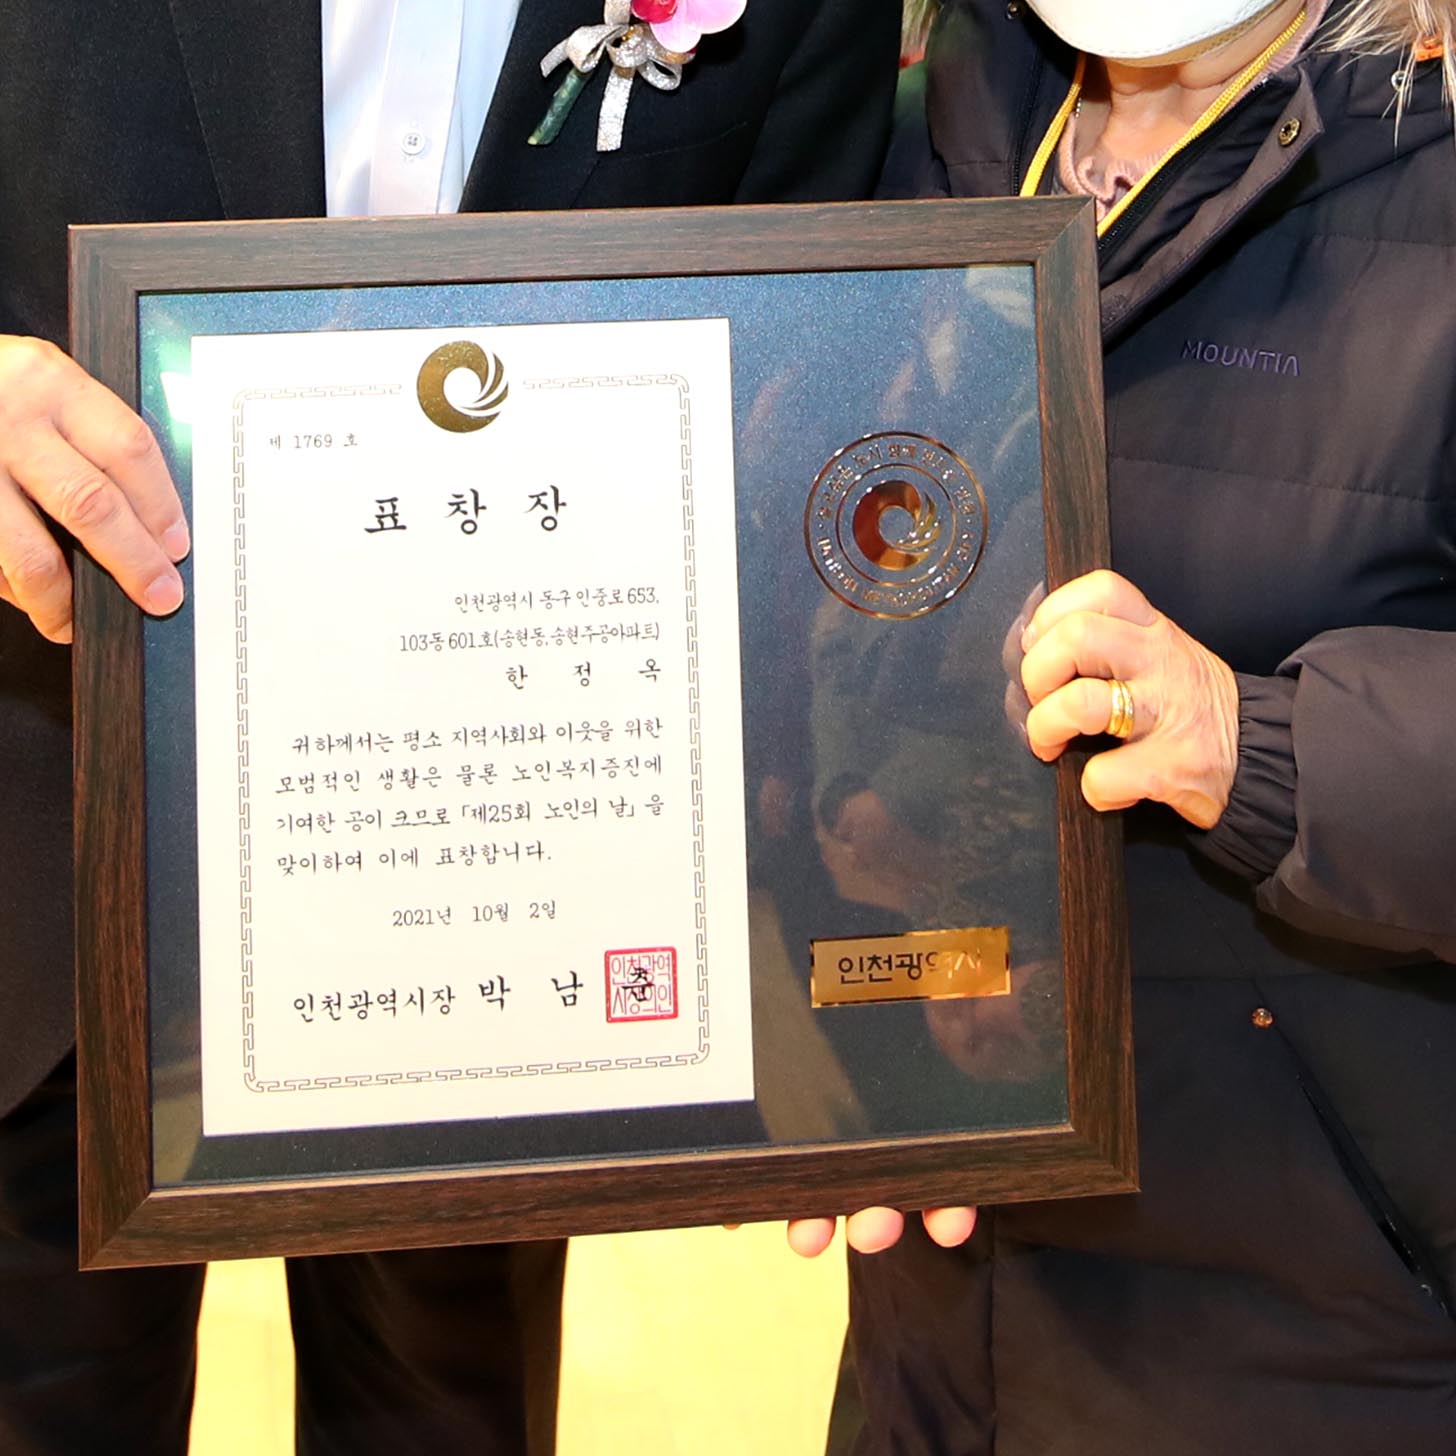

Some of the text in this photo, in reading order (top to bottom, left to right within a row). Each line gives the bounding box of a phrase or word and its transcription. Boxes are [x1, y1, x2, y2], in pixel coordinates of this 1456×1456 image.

[1180, 339, 1300, 377] MOUNTIA
[293, 433, 334, 449] 1769
[455, 590, 534, 613] 인천광역시
[539, 589, 572, 610] 동구
[400, 631, 445, 652] 103동
[505, 664, 529, 689] 한
[638, 658, 662, 682] 옥
[292, 717, 663, 756] 귀하께서는 평소 지역사회와 이웃을 위한
[275, 754, 662, 794] 모범적인 생활은 물론 노인복지증진에
[276, 811, 336, 835] 기여한
[344, 809, 382, 831] 공이
[391, 808, 451, 828] 크므로
[544, 797, 598, 821] 노인의
[277, 840, 552, 877] 맞이하여 이에 표창합니다.
[392, 899, 557, 927] 2021년 10월 2일
[293, 966, 656, 1023] 인천광역시장 박 남 춘
